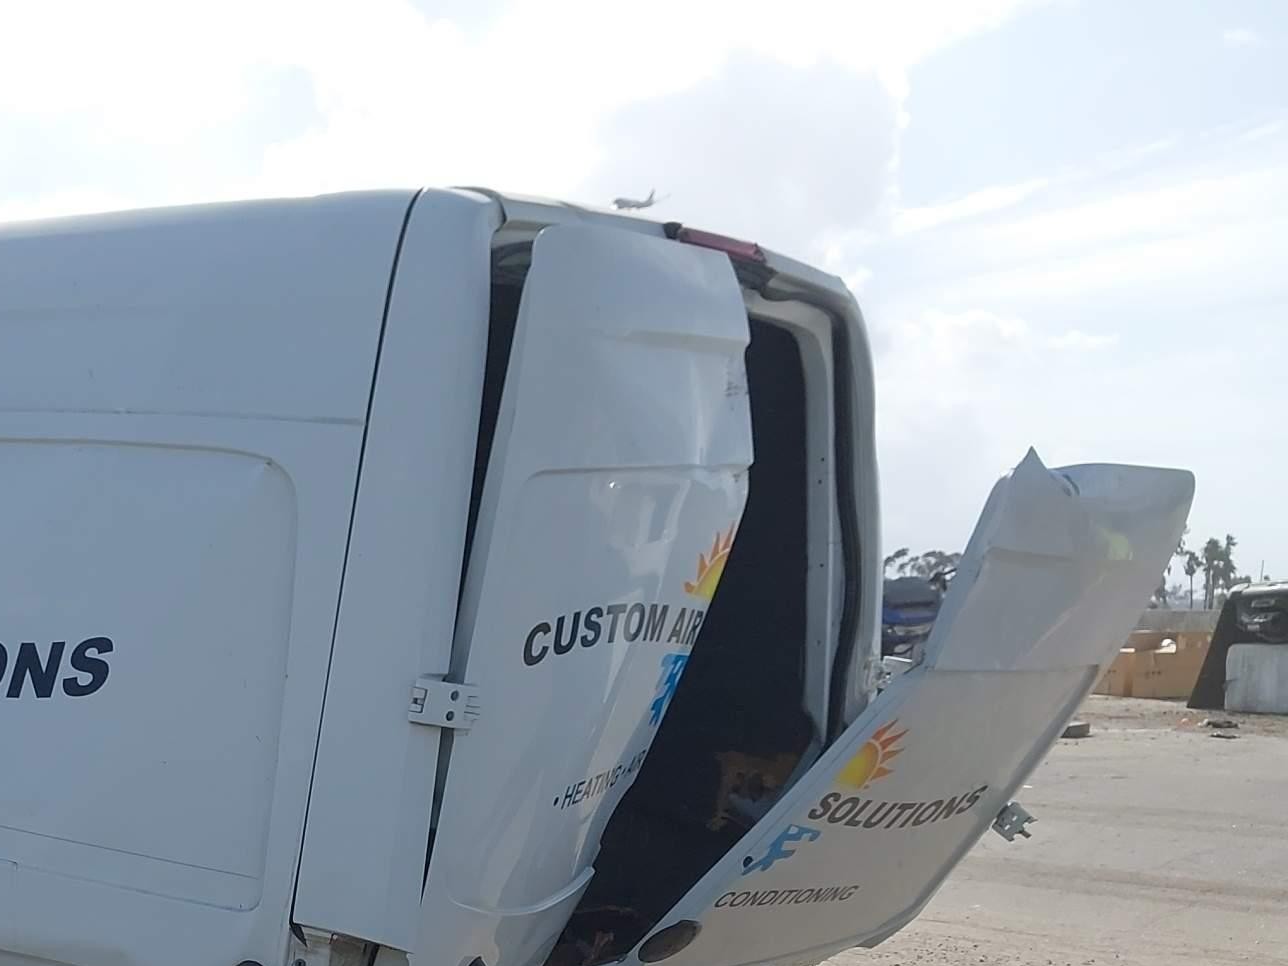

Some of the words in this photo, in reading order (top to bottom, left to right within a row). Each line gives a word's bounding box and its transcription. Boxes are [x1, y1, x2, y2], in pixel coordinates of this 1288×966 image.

[522, 602, 670, 667] CUSTOM
[667, 607, 704, 646] AIR
[807, 785, 989, 829] SOLUTIONS
[714, 885, 860, 909] CONDITIONING
